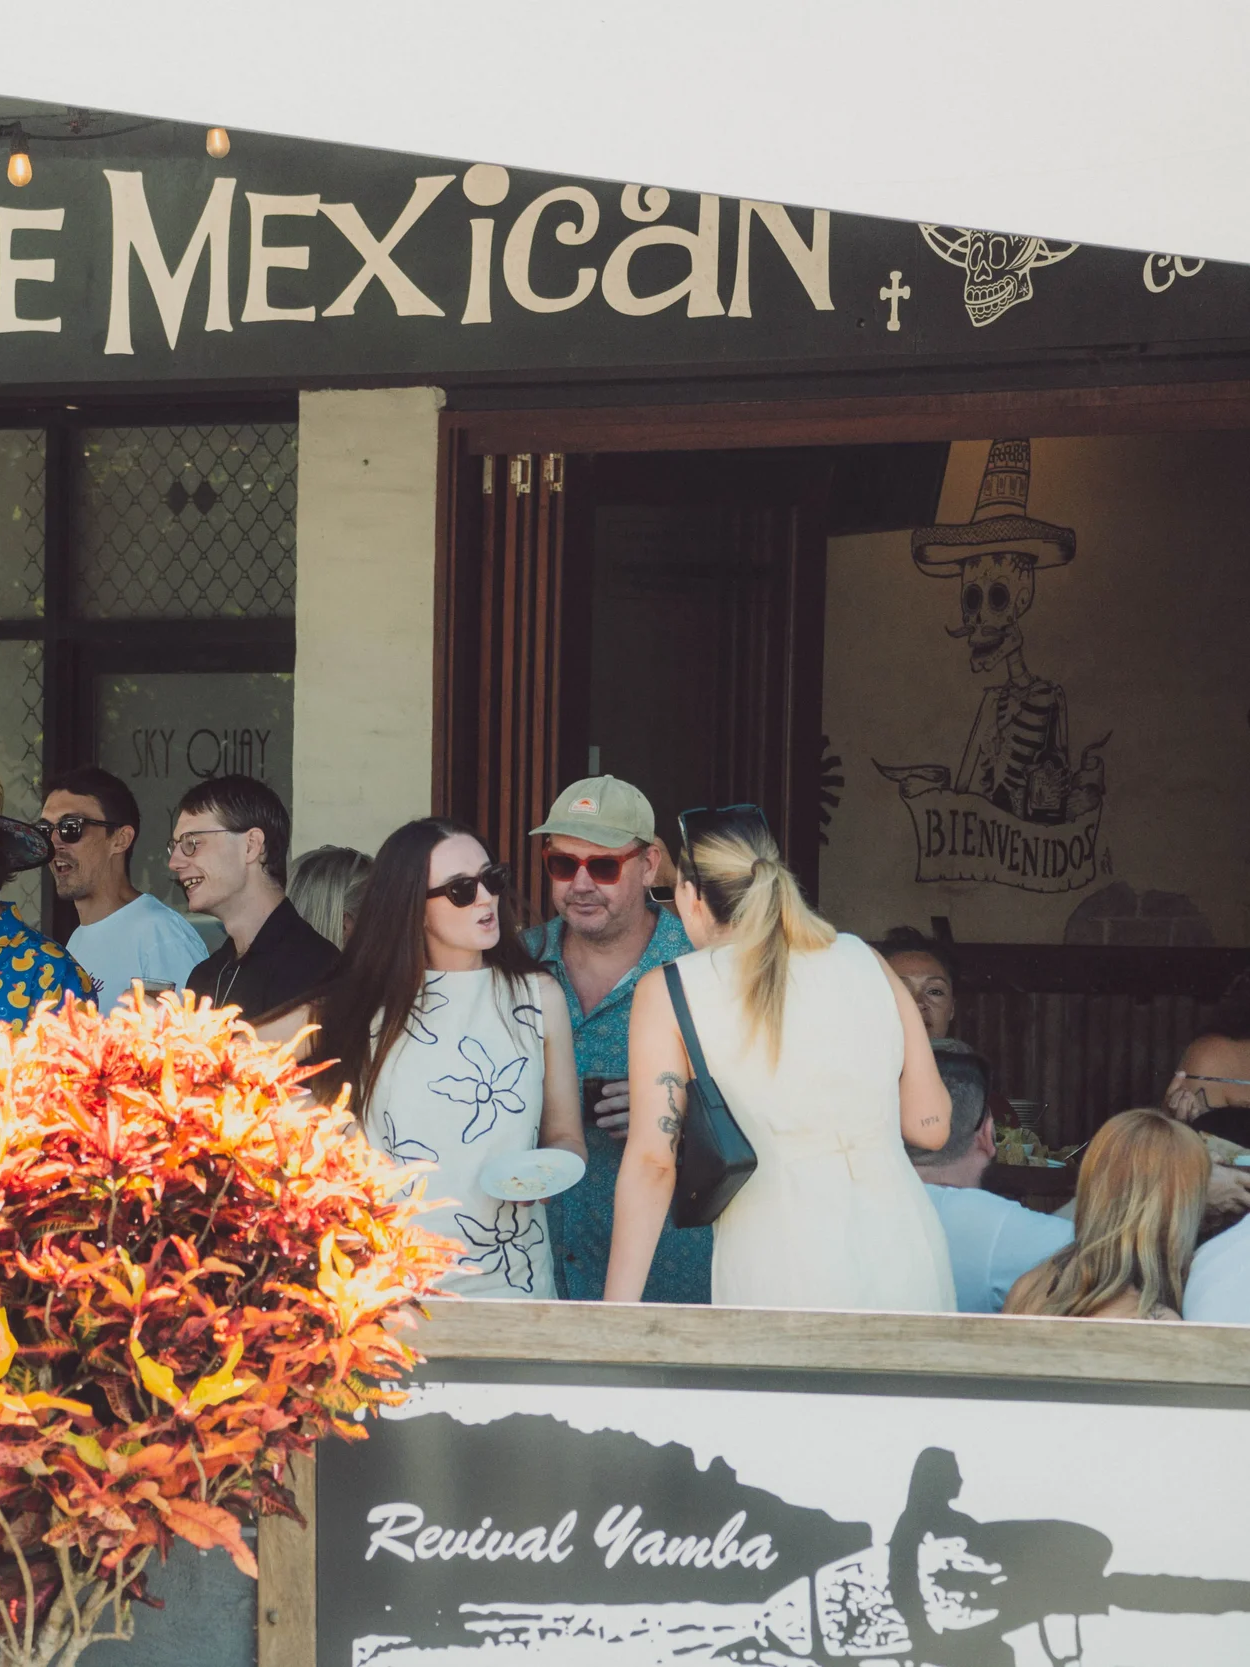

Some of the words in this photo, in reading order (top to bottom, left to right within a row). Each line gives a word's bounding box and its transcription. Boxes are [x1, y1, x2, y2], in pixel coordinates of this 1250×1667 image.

[131, 729, 175, 779] SKY
[187, 728, 271, 779] QUAY
[924, 809, 1095, 878] BIENVENIDOS
[363, 1501, 579, 1564] Revival
[592, 1504, 779, 1570] Yamba
